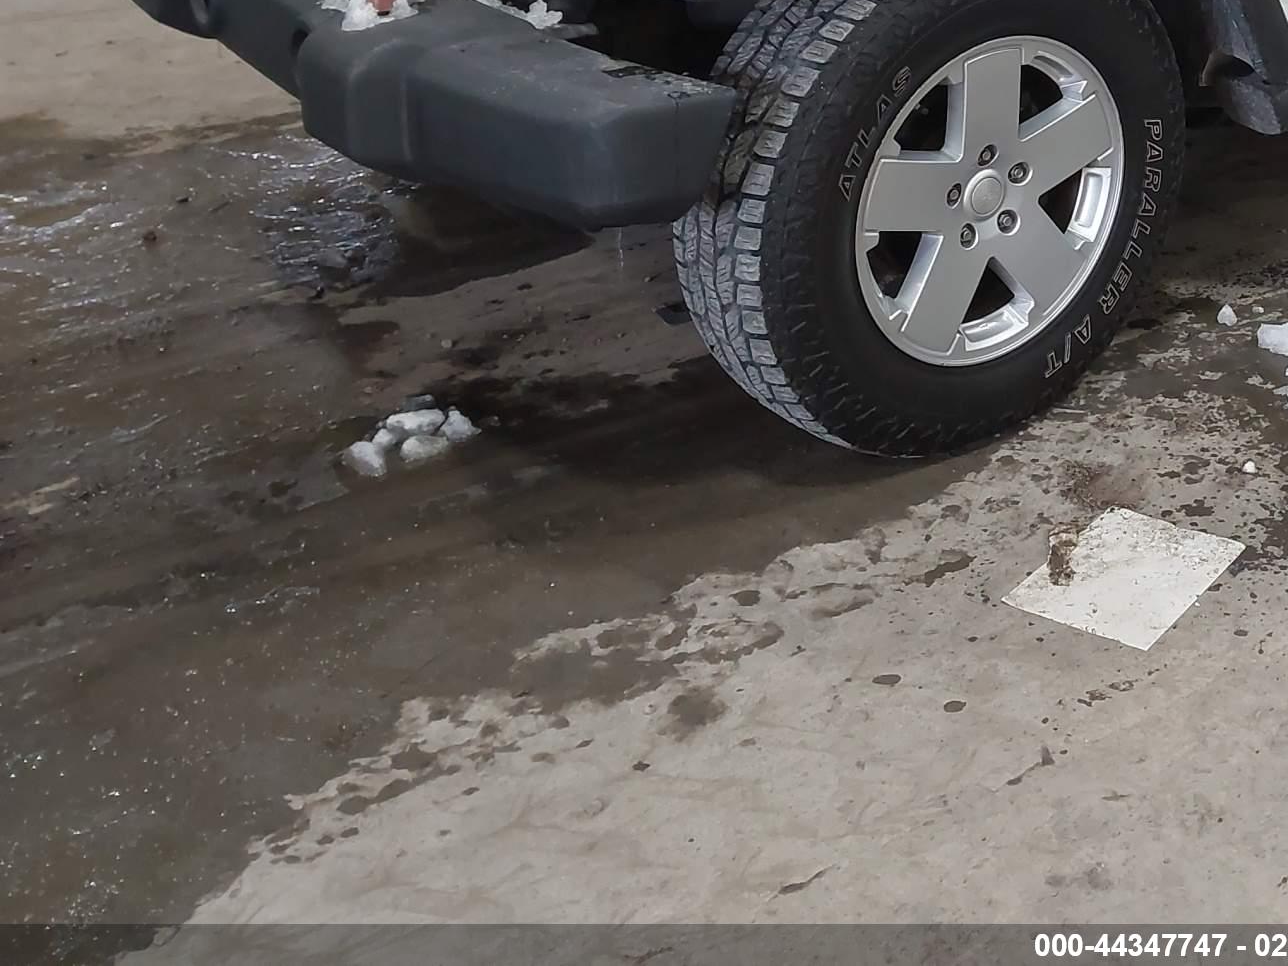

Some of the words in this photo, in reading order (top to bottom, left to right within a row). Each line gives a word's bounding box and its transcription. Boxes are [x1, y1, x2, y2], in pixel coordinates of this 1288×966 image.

[838, 66, 911, 202] ATLAS
[1099, 119, 1163, 315] PARALLER
[1044, 313, 1091, 378] A/T
